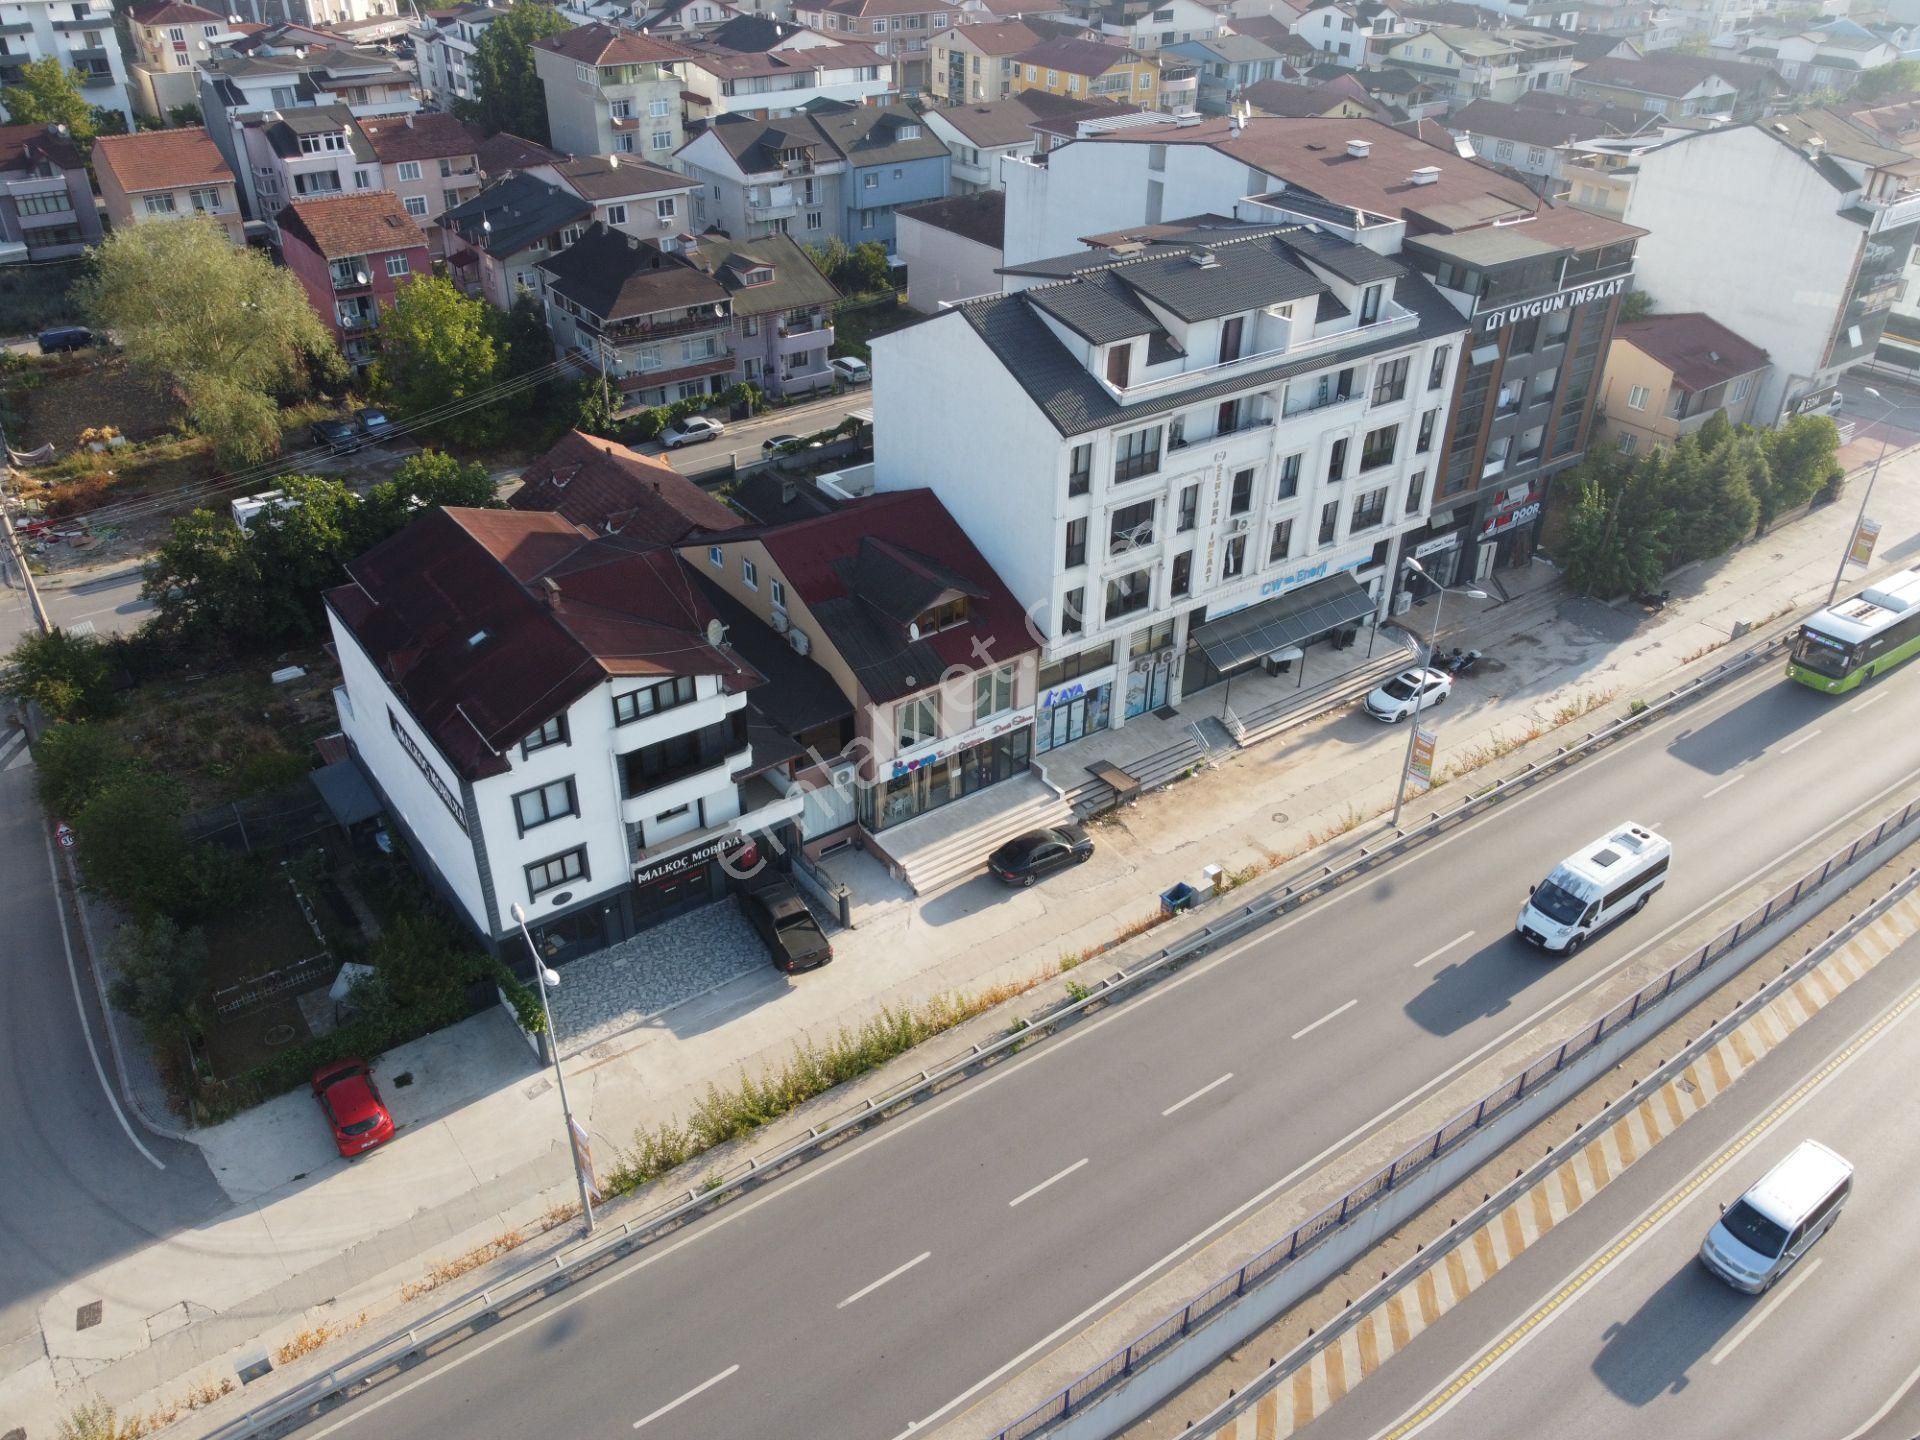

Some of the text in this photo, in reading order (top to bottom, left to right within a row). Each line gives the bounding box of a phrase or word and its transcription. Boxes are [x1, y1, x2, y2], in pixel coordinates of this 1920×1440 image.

[1509, 278, 1625, 323] UYGUN İNŞAAT
[1262, 577, 1284, 595] CW
[638, 856, 689, 884] MALKOÇ
[691, 836, 741, 861] MOBİLYA
